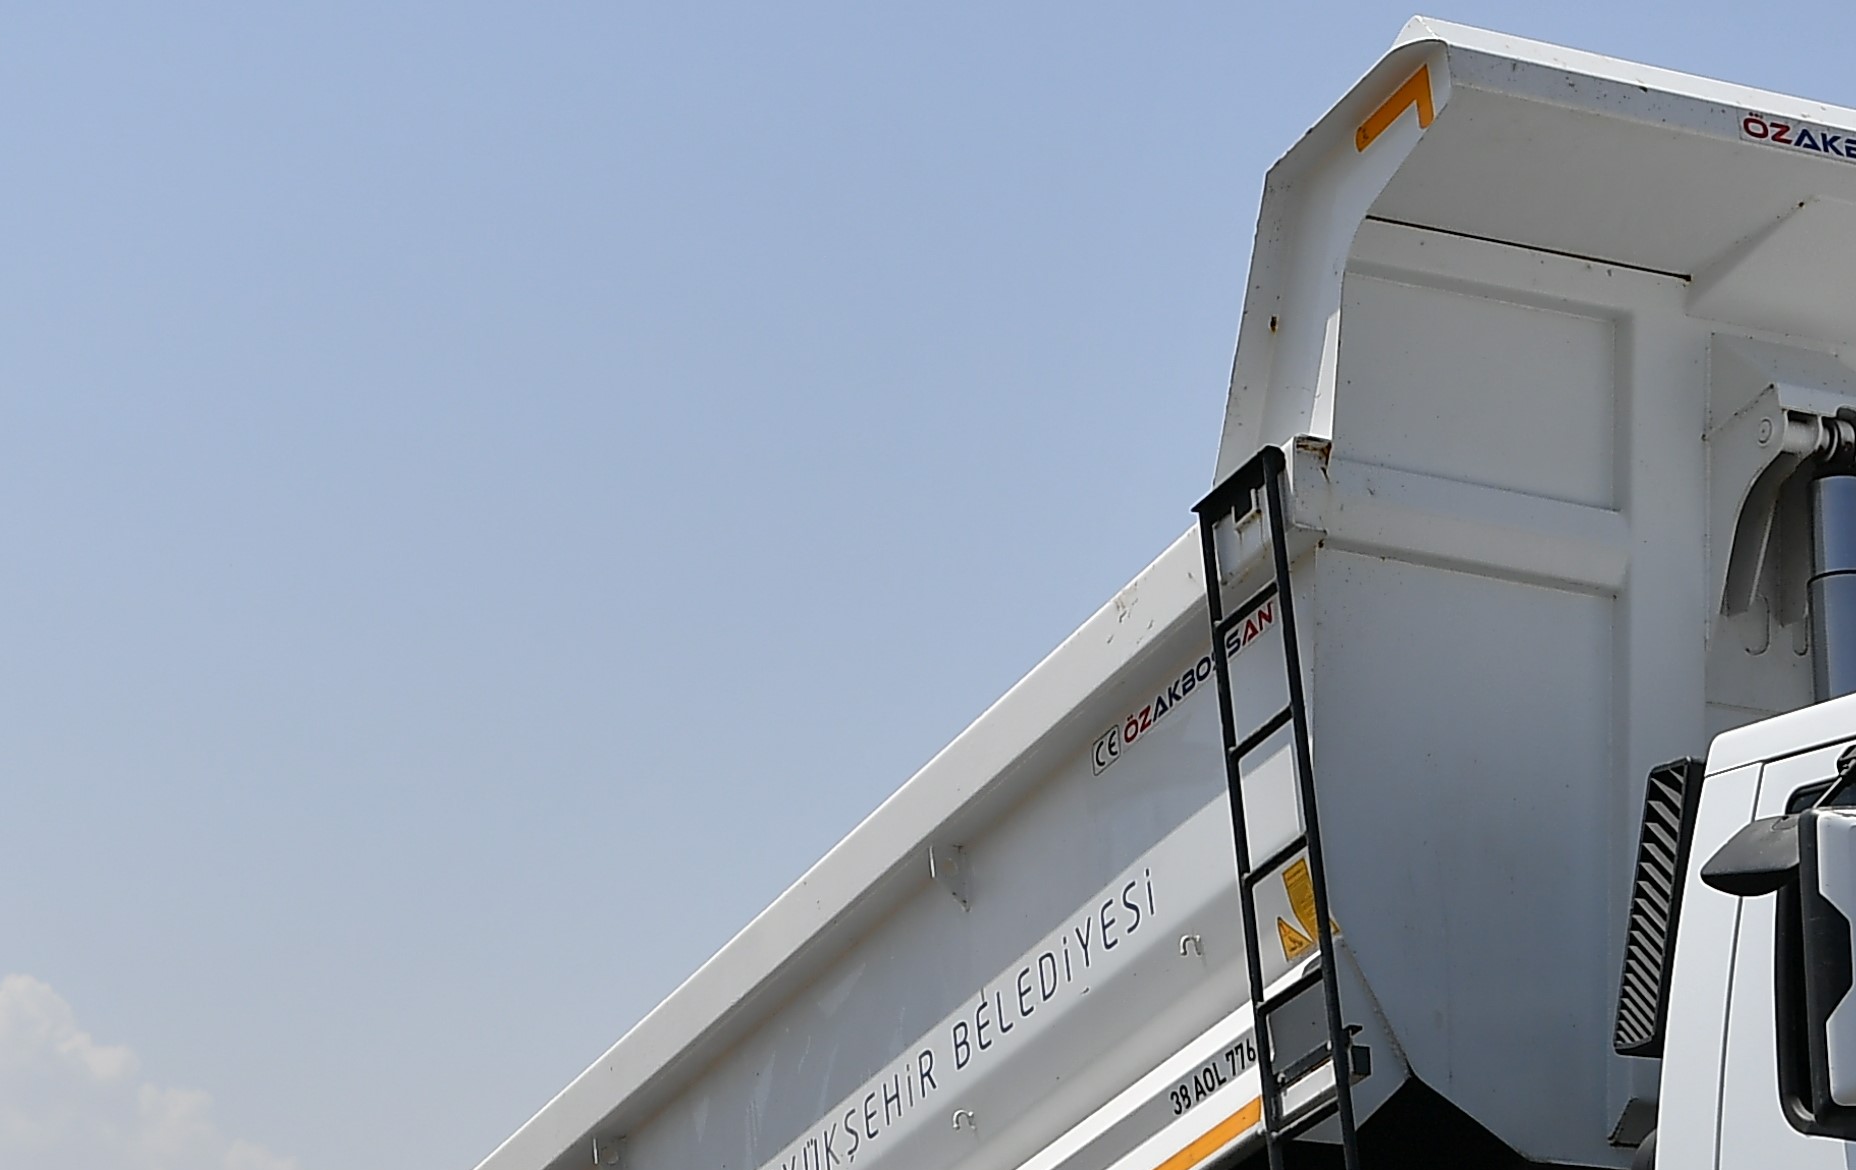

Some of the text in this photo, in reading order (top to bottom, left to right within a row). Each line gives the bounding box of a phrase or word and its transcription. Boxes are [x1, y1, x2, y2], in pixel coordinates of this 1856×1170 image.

[1123, 600, 1274, 743] ÖZAKBOSAN
[1169, 1037, 1257, 1116] 38 AOL 776
